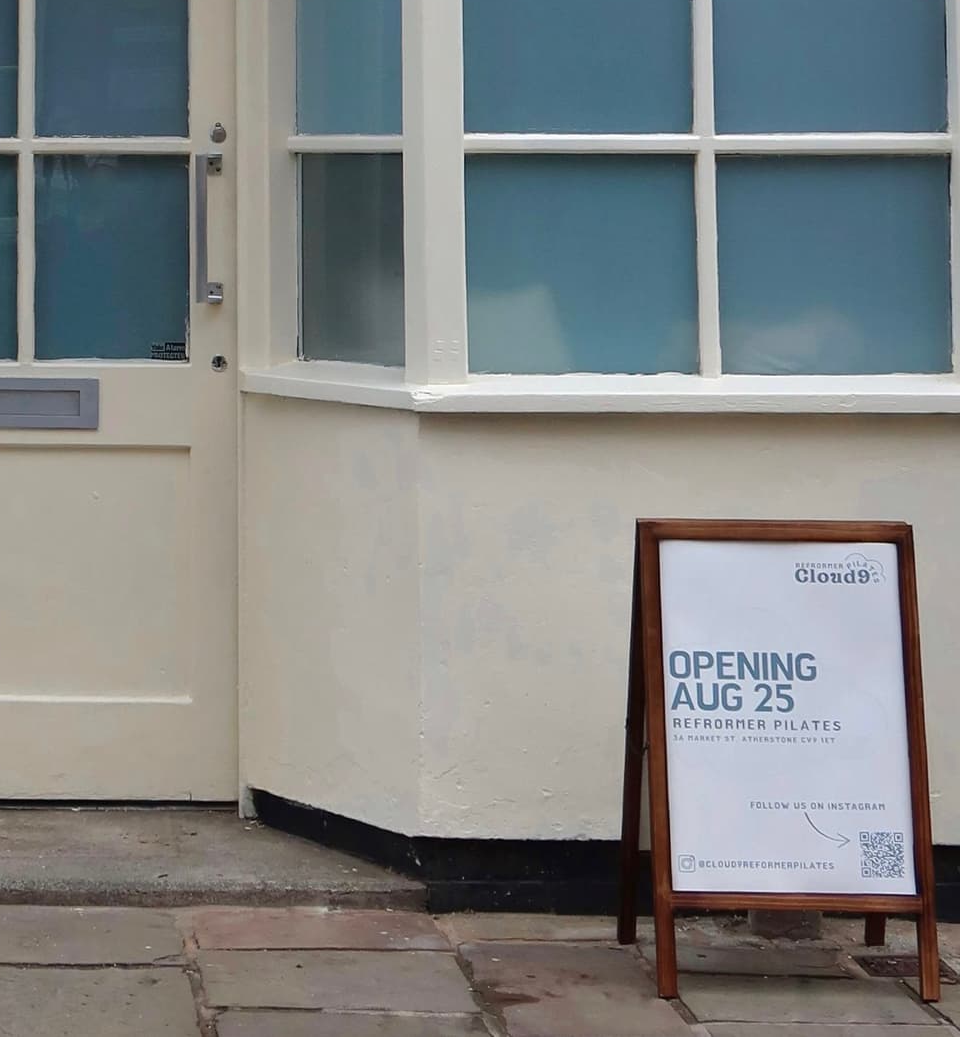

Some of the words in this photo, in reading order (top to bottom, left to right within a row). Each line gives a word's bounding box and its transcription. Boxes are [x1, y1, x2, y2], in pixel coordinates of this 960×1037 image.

[794, 568, 871, 584] Cloud9
[669, 650, 817, 682] OPENING
[671, 681, 743, 712] AUG
[754, 683, 795, 713] 25
[672, 717, 766, 731] REFRORMER
[773, 719, 842, 732] PILATES
[742, 735, 798, 743] ATHERSTONE
[750, 801, 789, 810] FOLLOW
[793, 802, 807, 810] US
[810, 802, 824, 810] ON
[827, 802, 886, 811] INSTAGRAM
